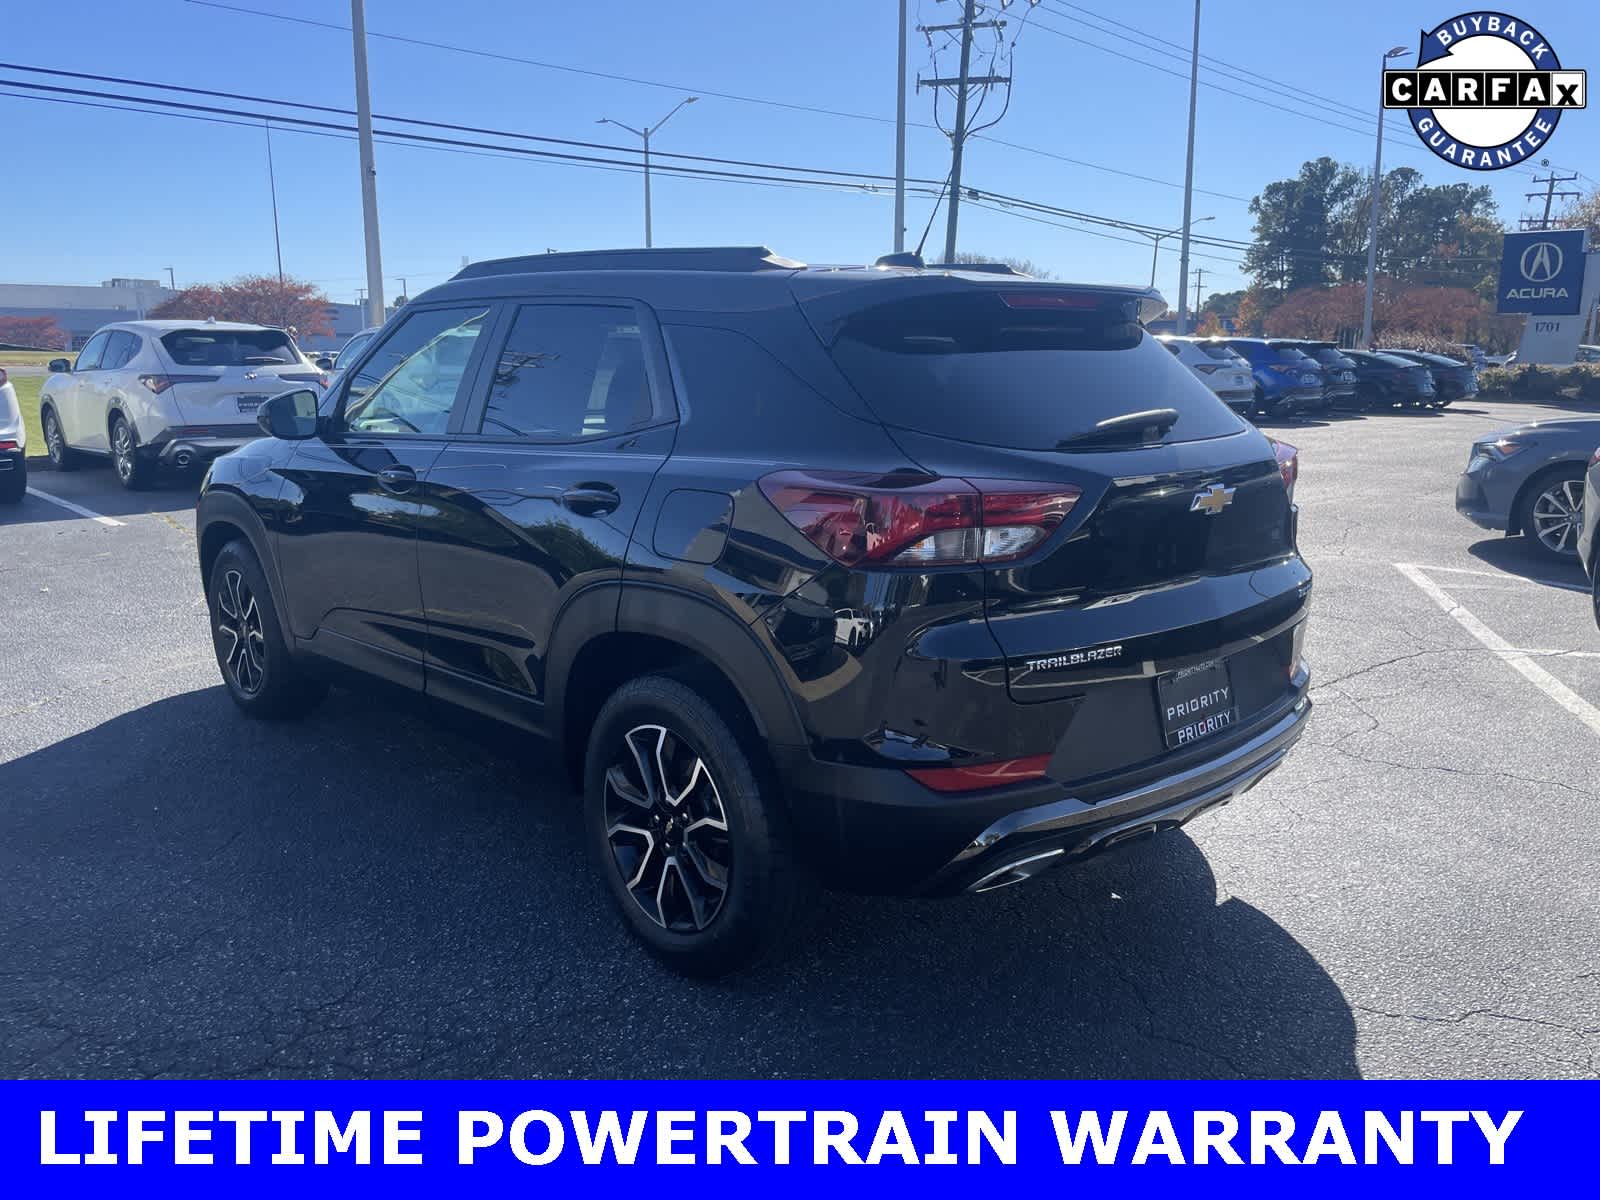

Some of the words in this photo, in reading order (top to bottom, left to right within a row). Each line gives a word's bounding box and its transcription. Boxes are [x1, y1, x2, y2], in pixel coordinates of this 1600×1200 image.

[1506, 287, 1569, 299] ACURA
[1535, 321, 1560, 333] 1701
[1026, 645, 1123, 672] TRAILBLAZER
[1166, 687, 1229, 721] PRIORITY
[1177, 711, 1231, 744] PRIORITY
